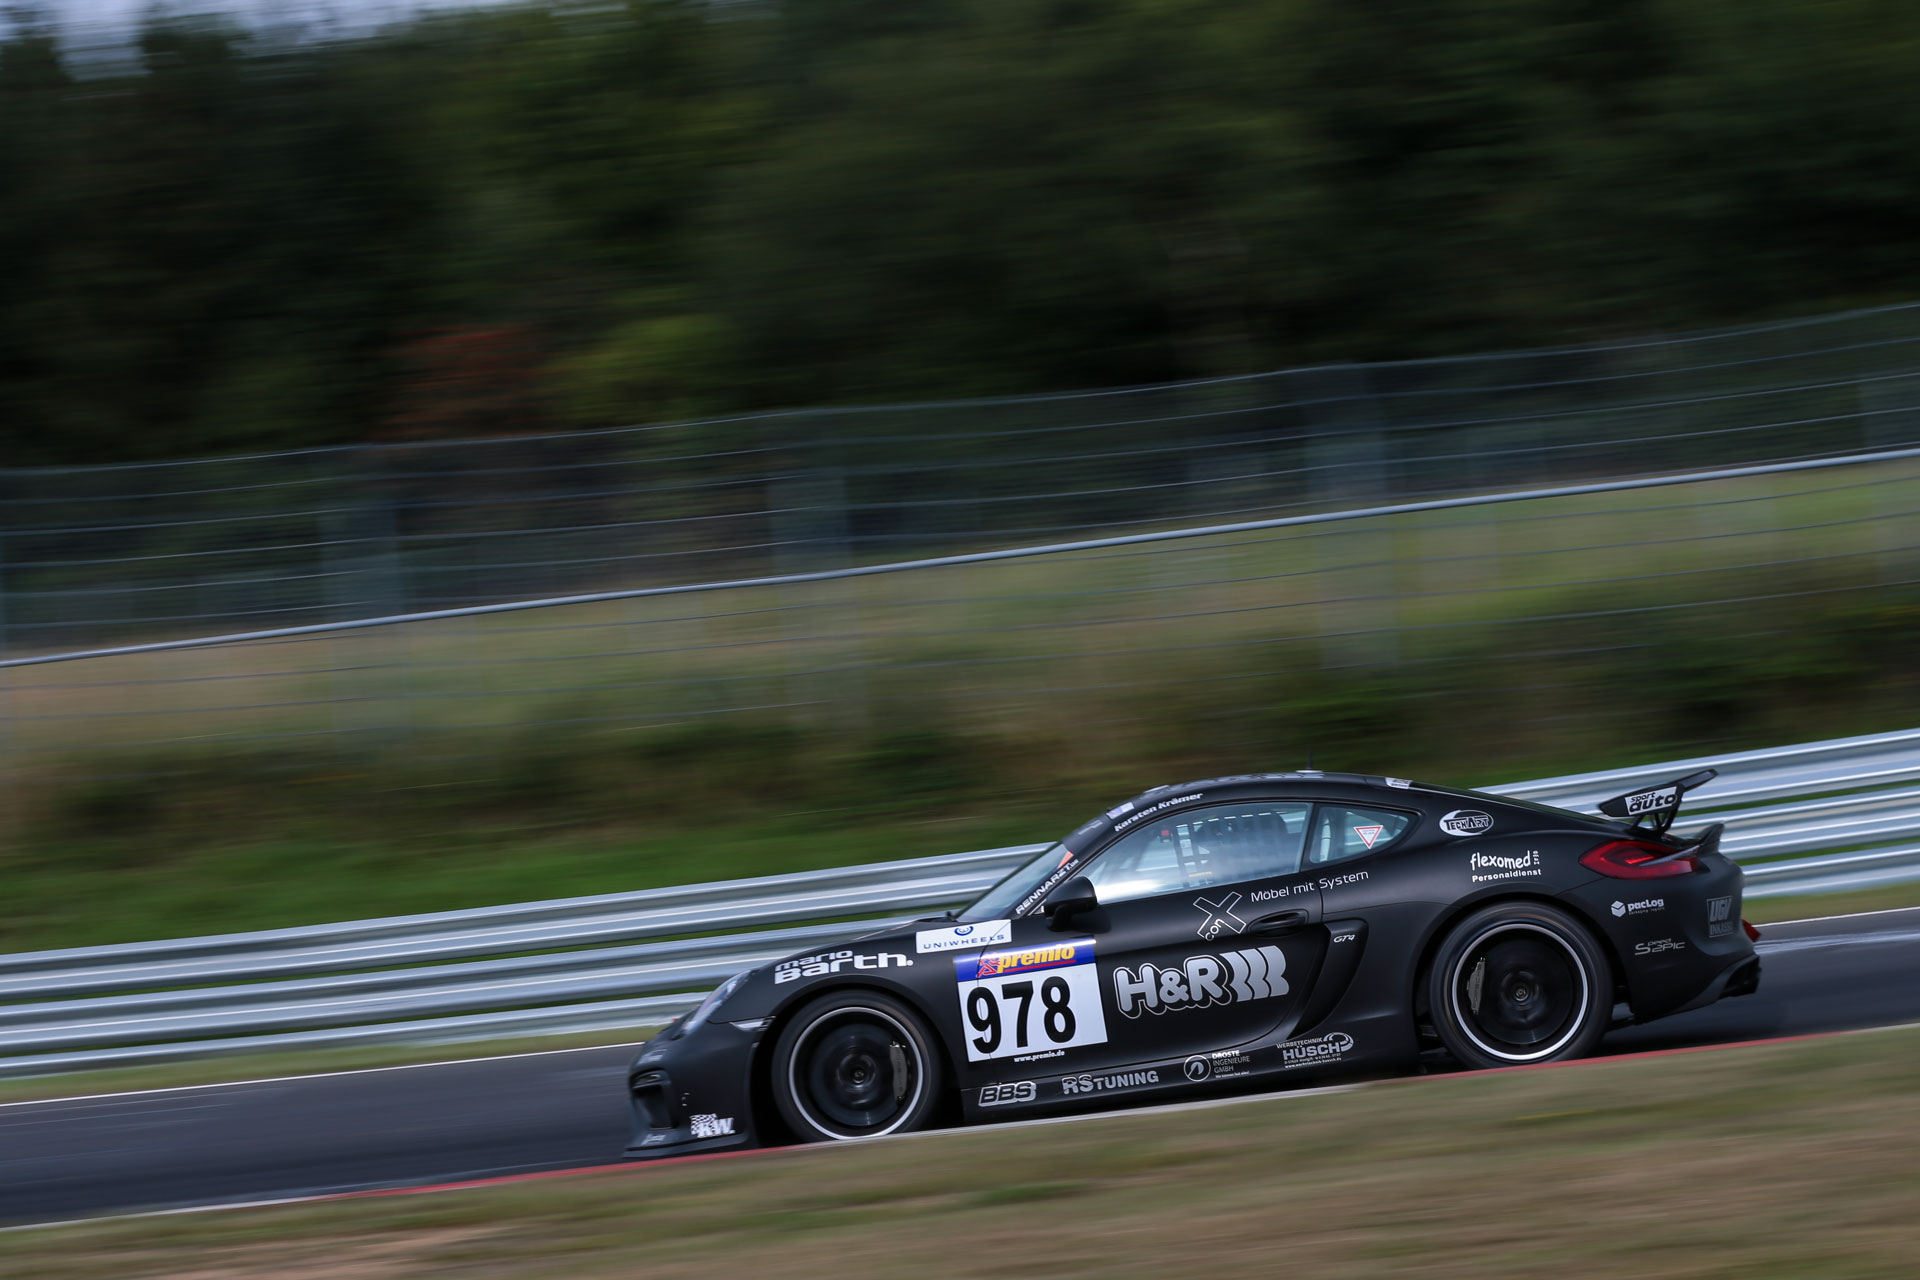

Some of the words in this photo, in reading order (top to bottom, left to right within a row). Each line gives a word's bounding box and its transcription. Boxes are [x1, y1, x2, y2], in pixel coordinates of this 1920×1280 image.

[1629, 794, 1677, 812] auto
[1630, 791, 1656, 803] sport
[1114, 805, 1157, 832] Karsten
[1157, 792, 1204, 810] Krämer
[1470, 850, 1531, 871] flexomed
[1472, 868, 1542, 882] Personaldienst
[1251, 886, 1290, 903] Möbel
[1293, 881, 1315, 894] mit
[1319, 871, 1369, 889] System
[923, 934, 1005, 949] UNIWHEELS
[1333, 934, 1356, 943] GT4
[775, 950, 853, 972] mario
[997, 945, 1076, 974] premio
[1114, 955, 1228, 1016] H&R
[967, 976, 1076, 1054] 978
[1276, 1037, 1323, 1049] WERBETECHNIK
[1282, 1042, 1342, 1061] HÜSCH
[1014, 1050, 1065, 1062] www.premio.de
[1211, 1050, 1240, 1060] DROSTE
[1212, 1055, 1250, 1066] INGENIEURE
[1213, 1065, 1234, 1074] GMBH
[978, 1081, 1036, 1107] BBS
